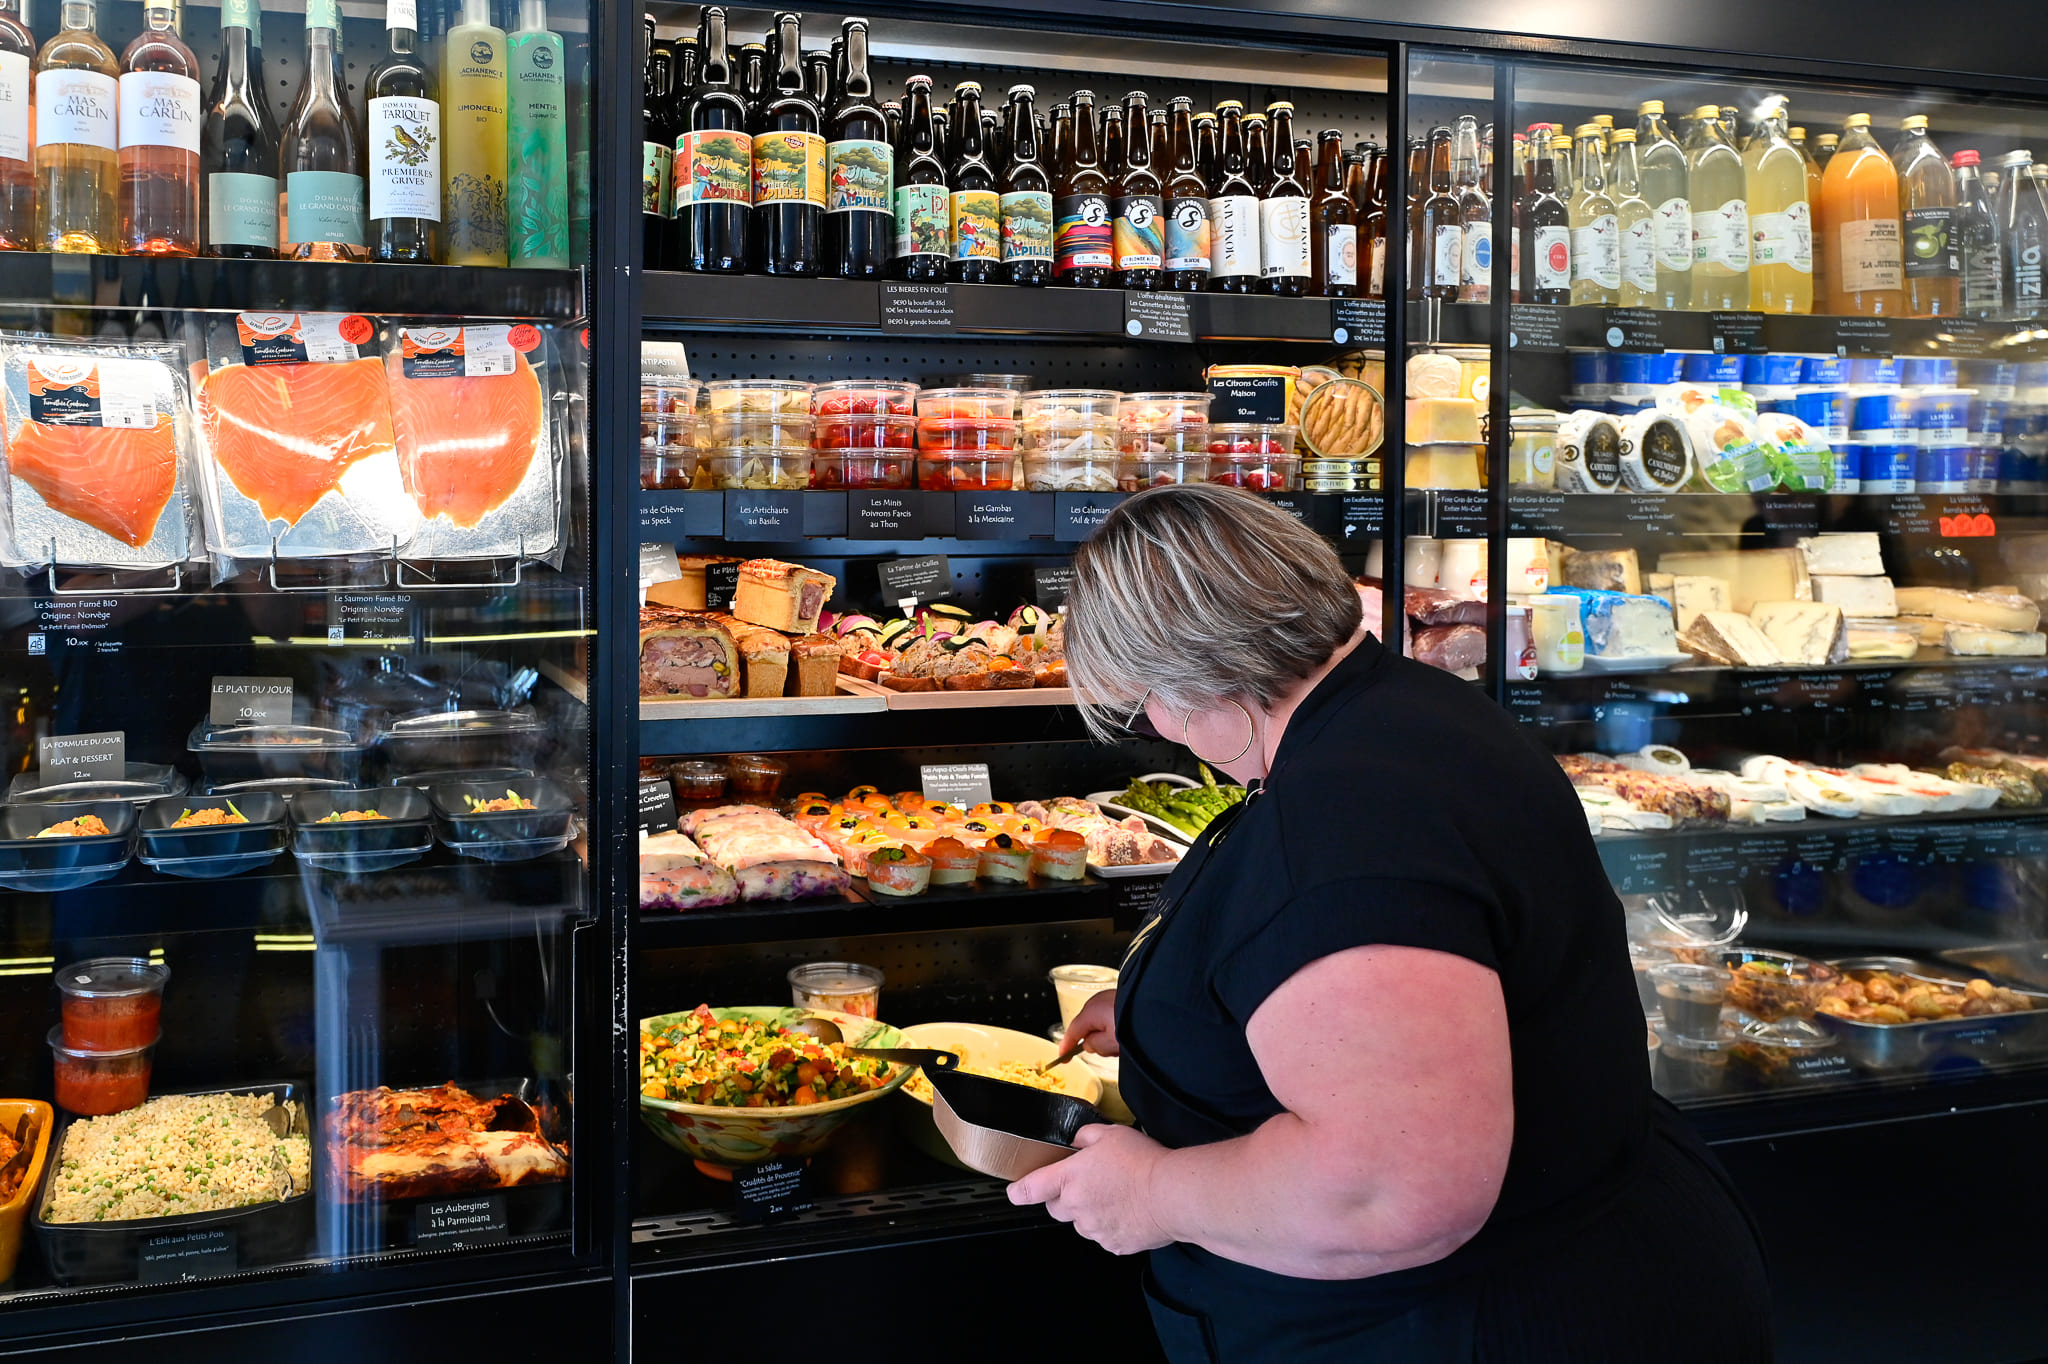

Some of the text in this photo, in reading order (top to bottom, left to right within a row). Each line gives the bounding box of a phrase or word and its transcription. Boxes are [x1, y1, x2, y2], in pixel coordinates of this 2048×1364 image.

[459, 67, 503, 77] LACHANENCE
[68, 95, 96, 107] MAS
[154, 97, 181, 109] MAS
[54, 103, 109, 121] CARLIN
[139, 106, 192, 123] CARLIN
[382, 109, 431, 124] TARIQUET
[392, 176, 425, 186] GRIVES
[701, 185, 750, 200] ALPILLE
[308, 203, 335, 211] GRAND
[1006, 245, 1052, 258] ALPILLE
[930, 286, 949, 294] FOLIE
[1213, 378, 1279, 388] Les Citrons Confits
[1230, 389, 1257, 398] Maison
[871, 499, 902, 507] Les Minis
[649, 505, 684, 514] de Chèvre
[740, 505, 789, 514] Les Artichauts
[861, 509, 912, 518] Poivrons Farcis
[973, 504, 1012, 513] Les Gambas
[1070, 506, 1081, 514] Les
[640, 517, 672, 526] au Speck
[748, 517, 780, 525] au Basilic
[880, 520, 899, 528] Thon
[974, 514, 980, 523] la
[981, 514, 1015, 524] Mexicaine
[713, 567, 721, 575] Le
[375, 594, 396, 602] Fumé
[34, 599, 118, 609] Le Saumon Fumé BIO
[340, 605, 404, 615] Origine Norvège
[41, 611, 111, 622] Origine Norvège
[64, 622, 80, 630] Fumé
[212, 684, 293, 694] LE PLAT DU JOUR
[42, 742, 53, 750] LA
[54, 739, 89, 749] FORMULE
[101, 736, 122, 745] JOUR
[50, 753, 114, 766] PLAT & DESSERT
[757, 1162, 783, 1174] La Salade
[431, 1201, 490, 1215] Les Aubergines
[431, 1219, 437, 1228] à
[438, 1217, 445, 1227] la
[171, 1230, 225, 1244] aux Petits Pois
